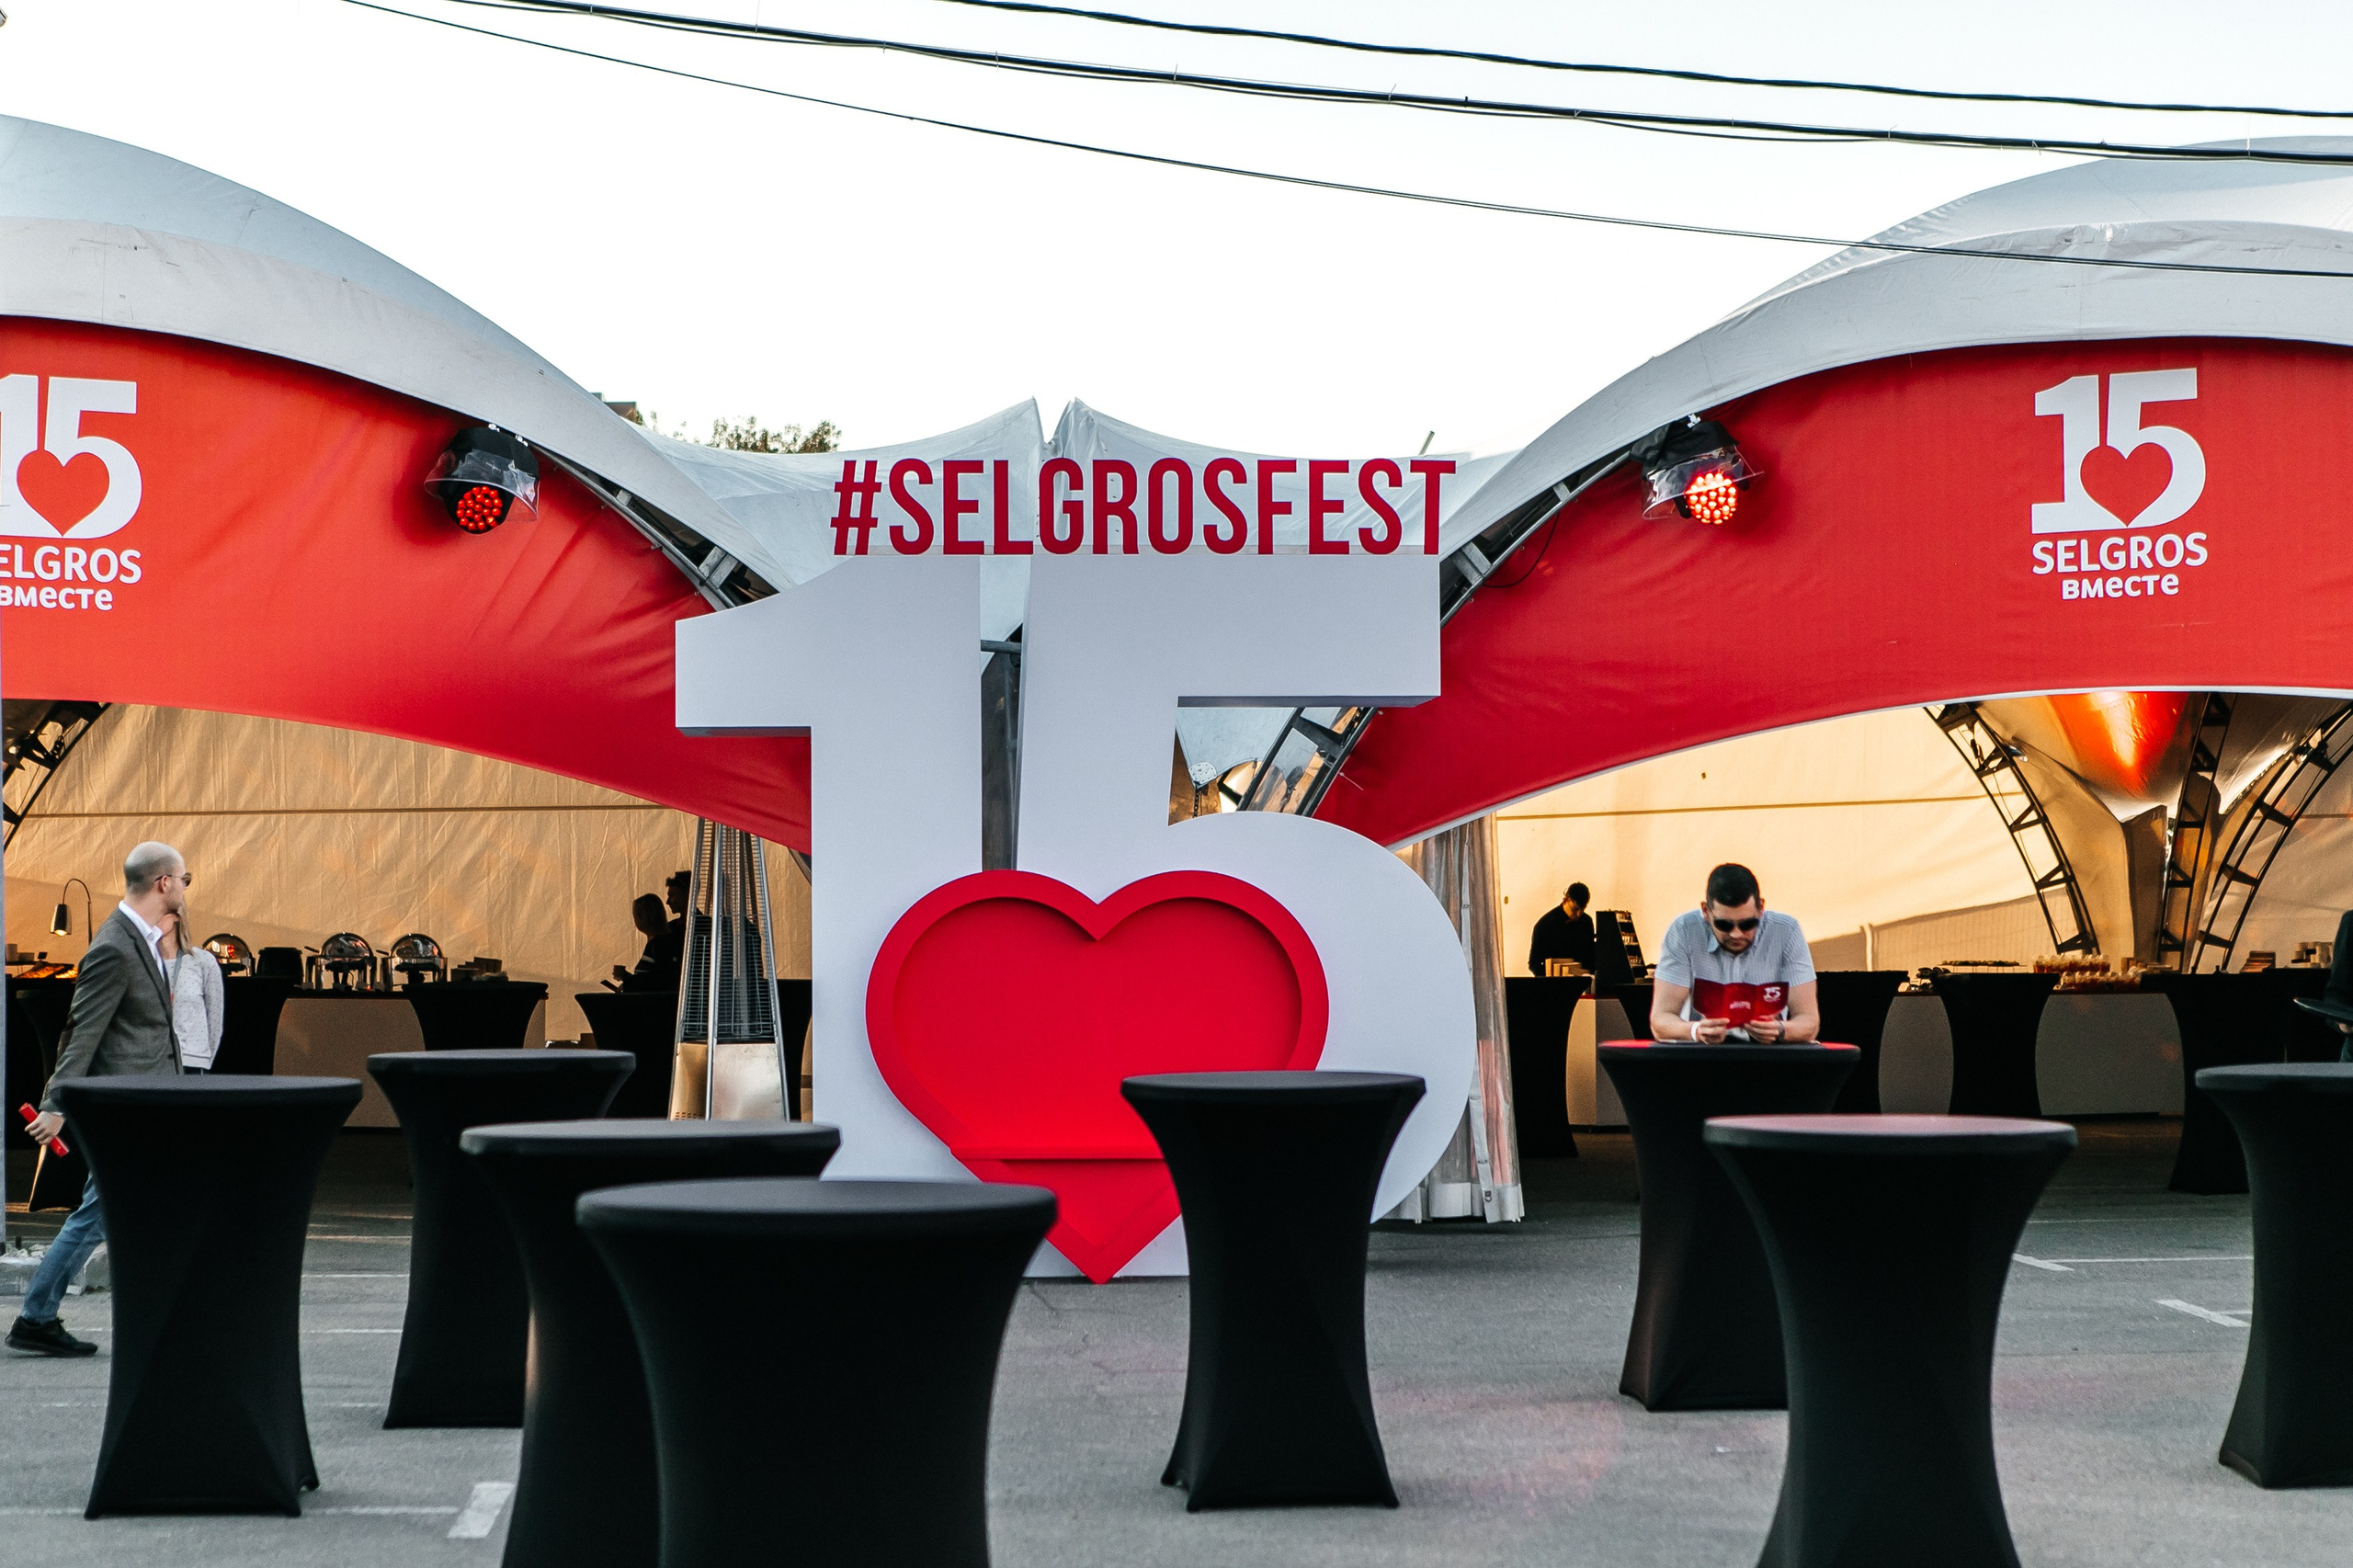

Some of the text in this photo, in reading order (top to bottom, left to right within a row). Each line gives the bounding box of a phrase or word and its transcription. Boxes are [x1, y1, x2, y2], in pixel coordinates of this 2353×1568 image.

[0, 373, 142, 539] 15
[830, 458, 1457, 556] #SELGROSFEST
[2031, 368, 2206, 534] 15
[0, 544, 142, 584] ELGROS
[2031, 531, 2208, 575] SELGROS
[676, 554, 1476, 1279] 15
